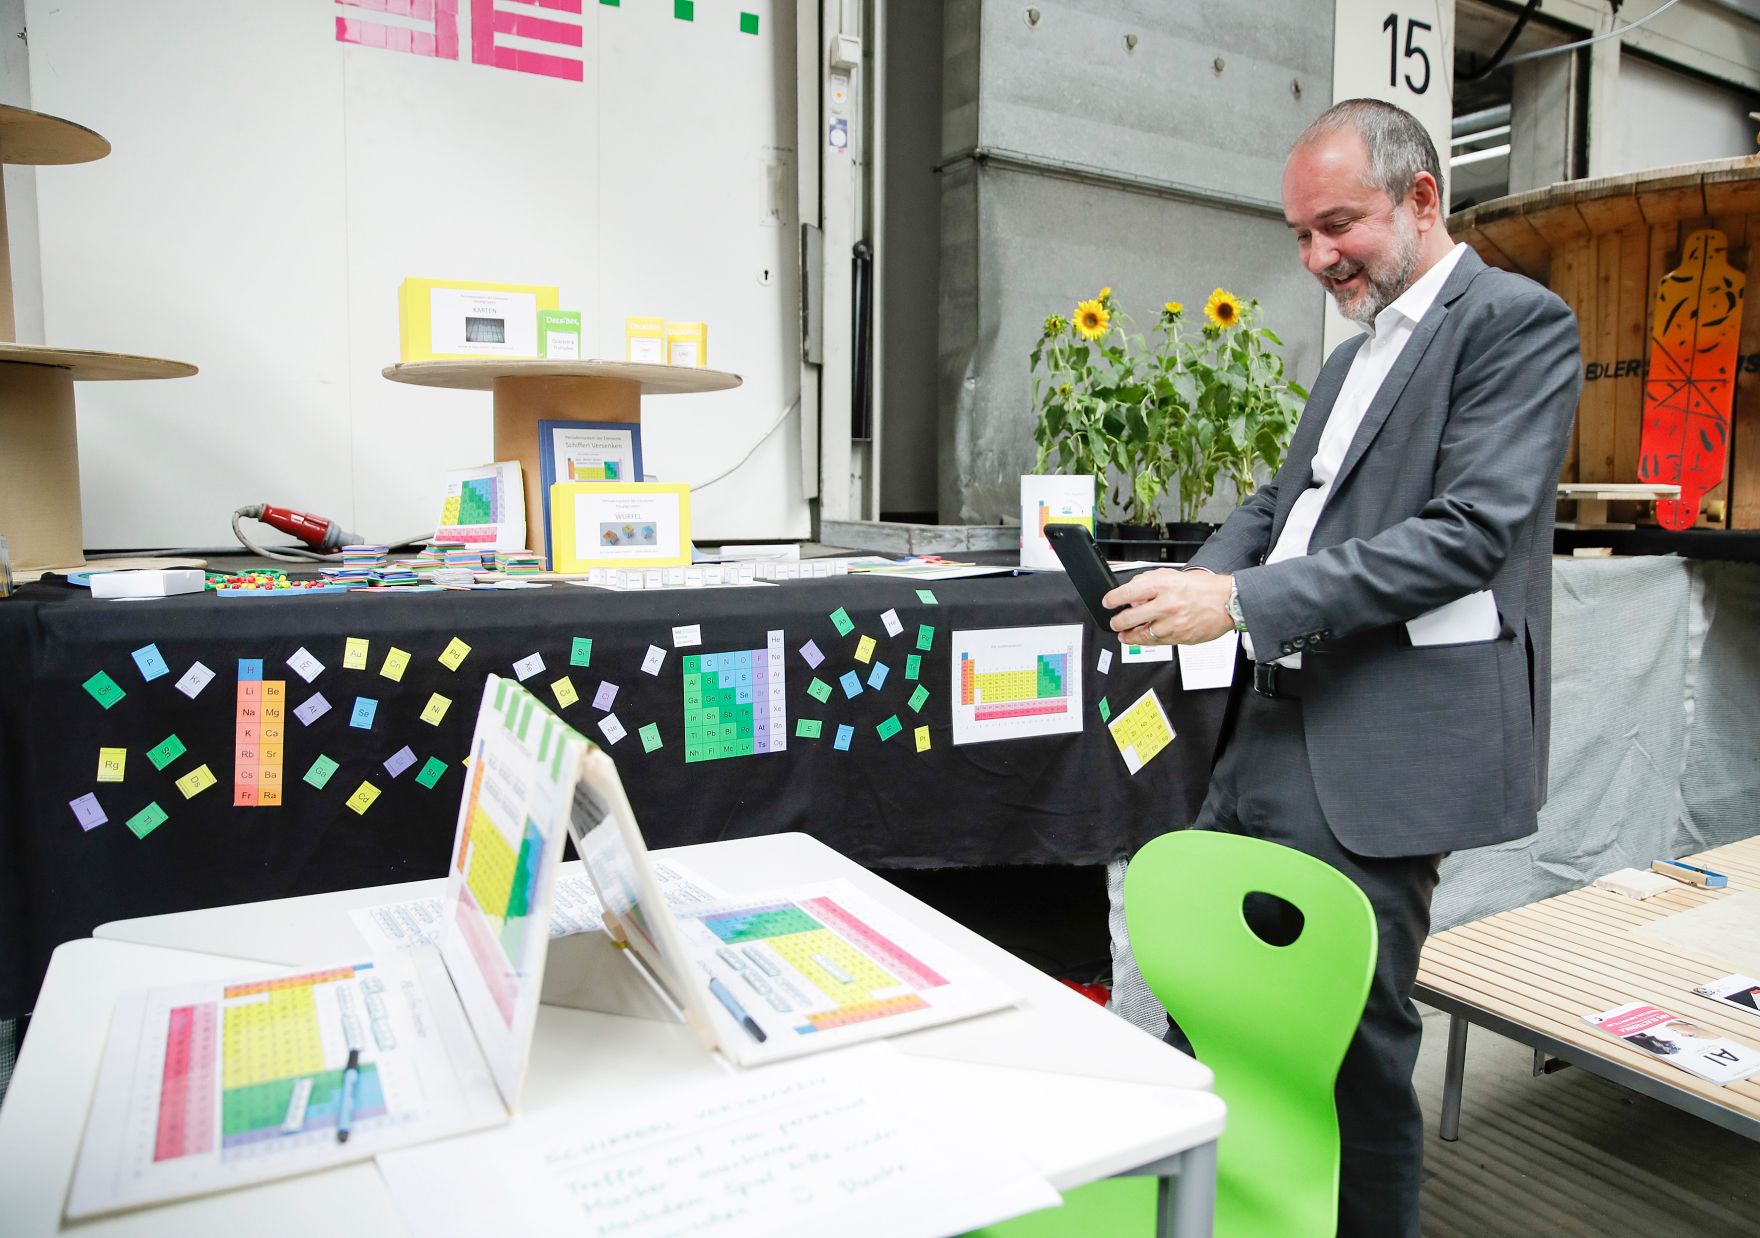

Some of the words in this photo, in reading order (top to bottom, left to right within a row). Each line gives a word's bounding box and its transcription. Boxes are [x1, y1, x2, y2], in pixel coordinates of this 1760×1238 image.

[1383, 13, 1432, 95] 15
[473, 306, 497, 315] KARTEN
[245, 687, 254, 695] Li
[267, 687, 280, 696] Be
[265, 708, 280, 718] Mg
[265, 729, 278, 737] Ca
[241, 750, 254, 758] Rb
[266, 750, 277, 758] Sr
[105, 760, 119, 771] Rg
[241, 771, 253, 779] Cs
[264, 770, 277, 779] Ba
[241, 791, 252, 799] Fr
[263, 791, 276, 799] Ra
[1703, 1048, 1740, 1067] AI
